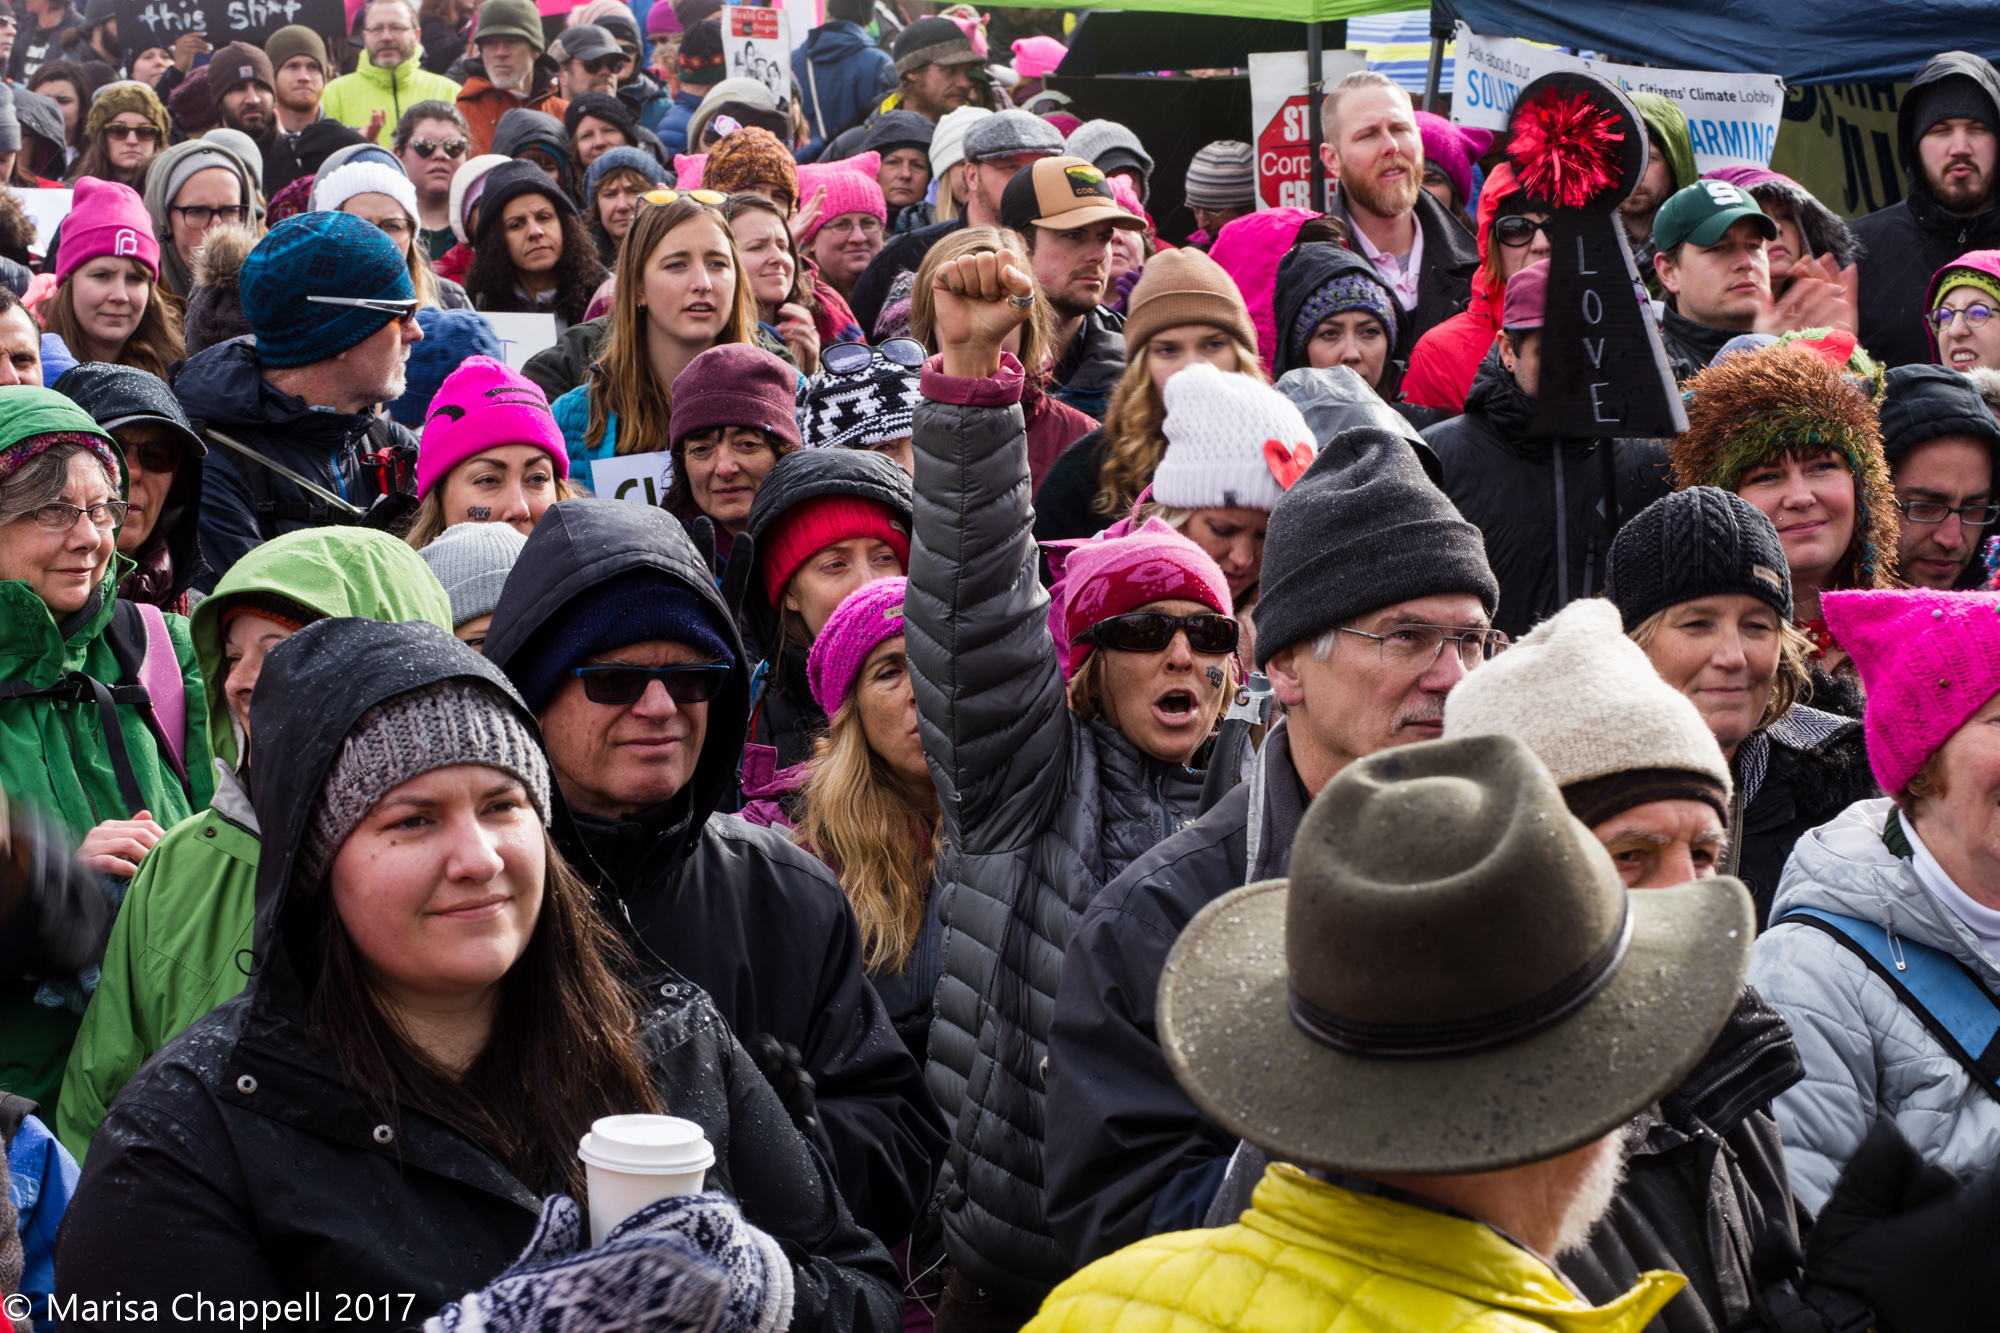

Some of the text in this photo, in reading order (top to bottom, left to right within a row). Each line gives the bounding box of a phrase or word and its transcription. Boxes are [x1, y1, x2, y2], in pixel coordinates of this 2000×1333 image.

[138, 0, 207, 32] this
[1468, 43, 1531, 80] Ask about our
[1690, 88, 1737, 102] Climate
[1739, 90, 1775, 107] Lobby
[1576, 235, 1620, 422] LOVE
